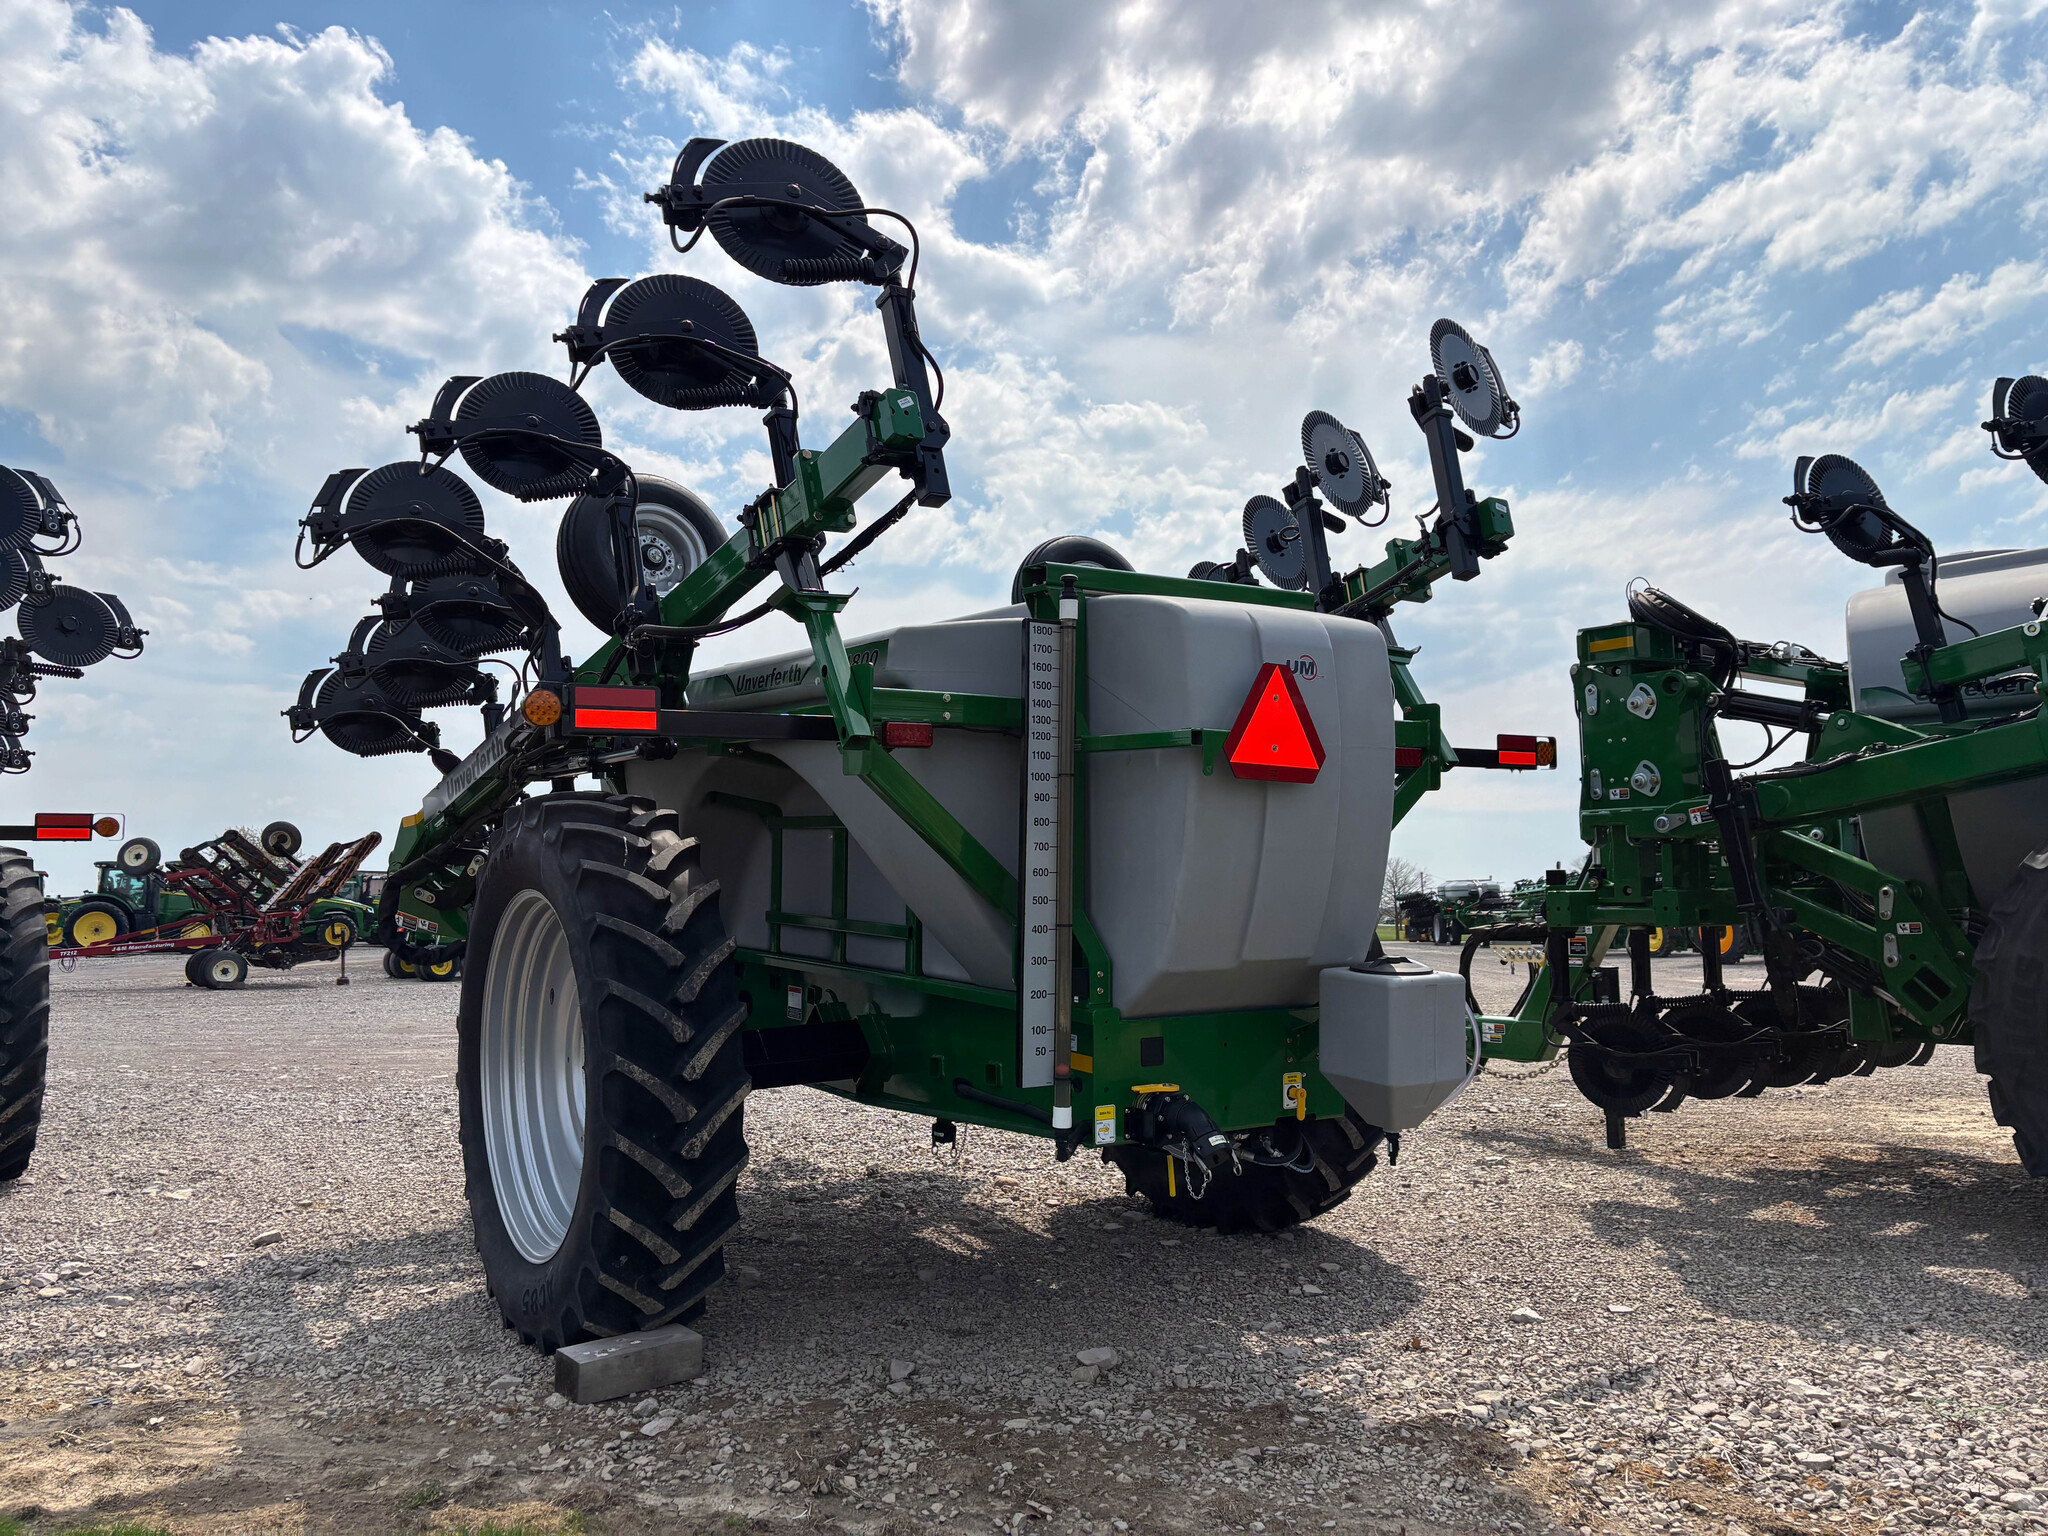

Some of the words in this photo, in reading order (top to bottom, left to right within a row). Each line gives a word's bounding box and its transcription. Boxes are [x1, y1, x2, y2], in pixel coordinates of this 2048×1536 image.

[1032, 626, 1053, 636] 1800
[1032, 644, 1053, 654] 1700
[1031, 662, 1052, 672] 1600
[1286, 659, 1315, 676] UM
[736, 663, 802, 693] Unverferth
[1031, 680, 1052, 691] 1500
[1031, 699, 1052, 709] 1400
[1031, 715, 1052, 725] 1300
[1031, 731, 1051, 741] 1200
[1031, 751, 1051, 761] 1100
[446, 735, 504, 800] Unverferth
[1030, 772, 1051, 782] 1000
[1034, 793, 1050, 802] 900
[1033, 817, 1050, 827] 800
[1033, 842, 1050, 851] 700
[1032, 868, 1049, 877] 600
[1032, 896, 1049, 905] 500
[1031, 924, 1048, 934] 400
[128, 941, 175, 951] Manufacturing
[1031, 956, 1048, 966] 300
[1030, 989, 1048, 1000] 200
[1031, 1025, 1047, 1035] 100
[1035, 1047, 1047, 1056] 50
